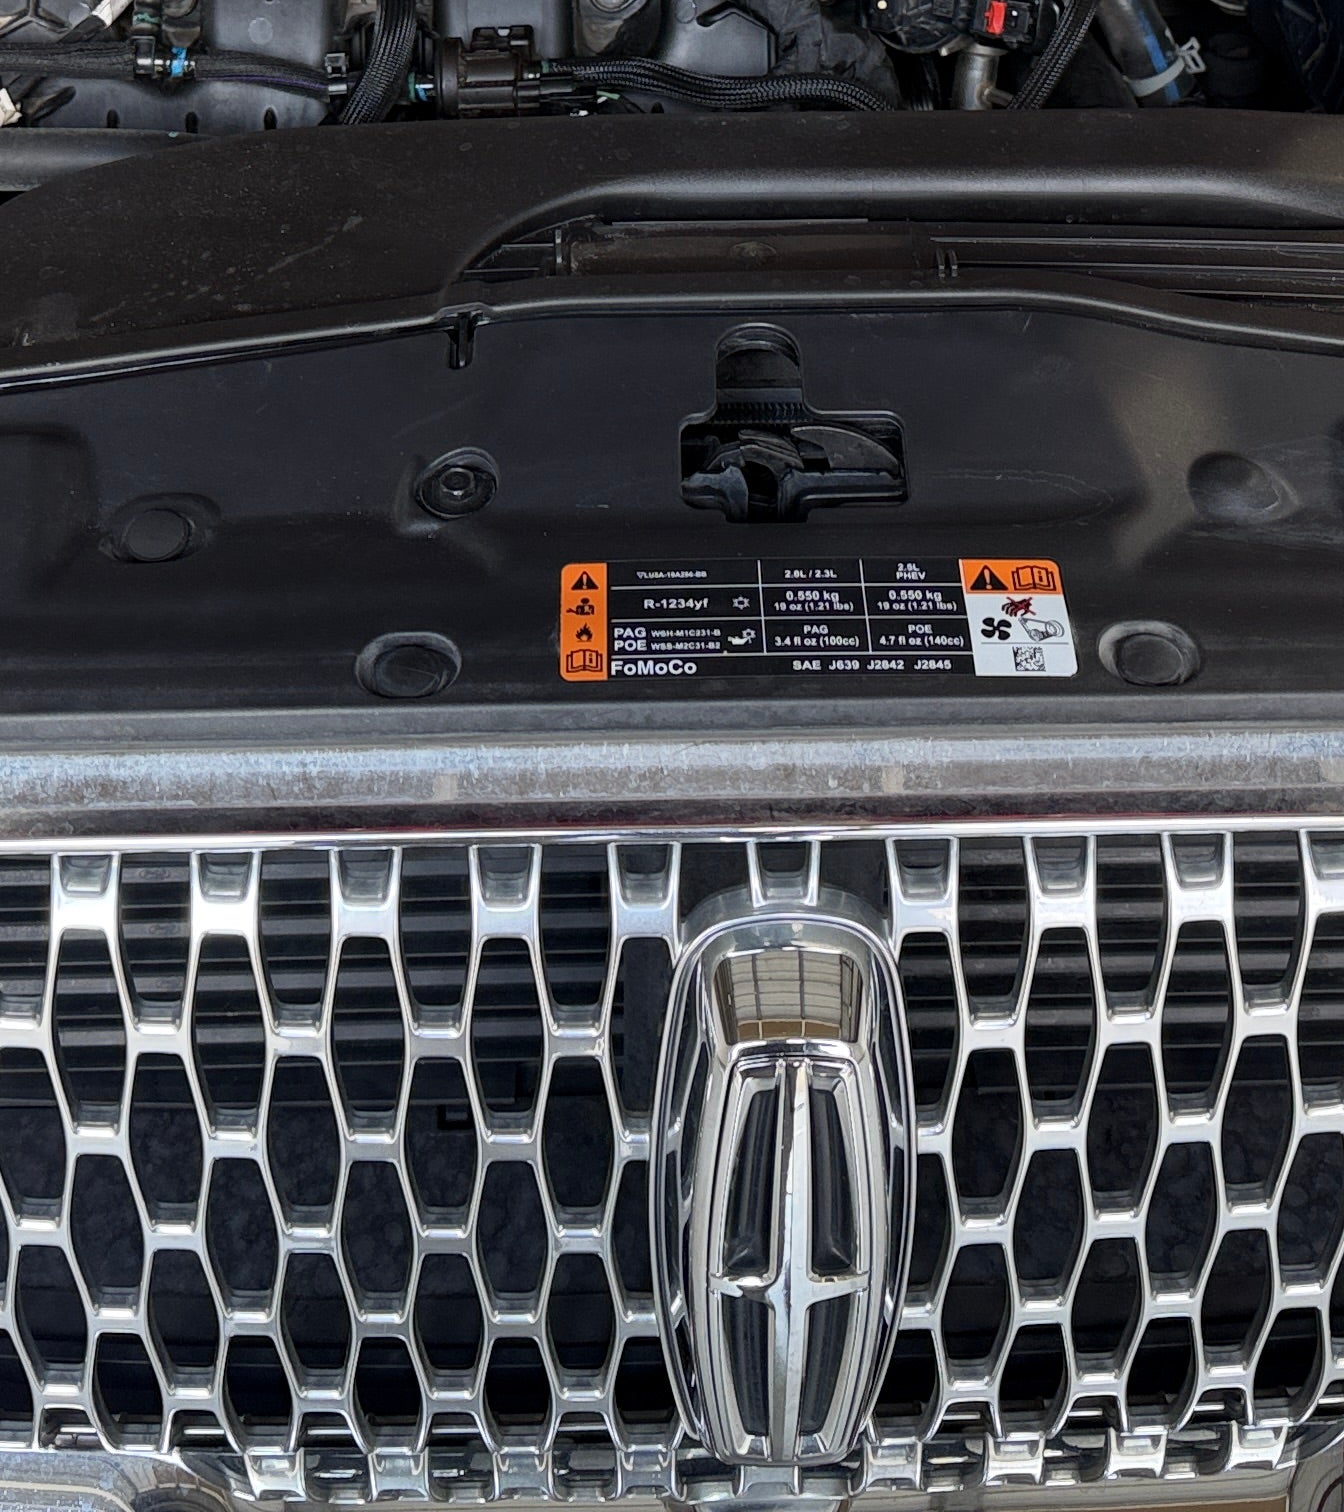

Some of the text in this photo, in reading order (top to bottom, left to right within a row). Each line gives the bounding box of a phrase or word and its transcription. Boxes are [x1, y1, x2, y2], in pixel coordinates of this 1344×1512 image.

[785, 570, 806, 578] 2.0L
[815, 569, 837, 578] 2.3L
[896, 572, 925, 580] PHEV
[786, 591, 839, 603] 0.550 kg
[889, 590, 942, 603] 0.550 kg
[644, 598, 708, 610] R-1234yf
[774, 602, 786, 611] 19
[805, 602, 829, 612] (1.21
[833, 600, 853, 611] lbs)
[878, 602, 889, 610] 19
[908, 601, 933, 611] (1.21
[936, 600, 956, 611] lbs)
[614, 627, 646, 638] PAG
[804, 625, 828, 634] PAG
[908, 624, 932, 634] POE
[614, 640, 647, 651] POE
[775, 636, 859, 647] 3.4 fl oz (100cc)
[880, 636, 895, 645] 4.7
[898, 636, 906, 645] fl
[925, 635, 964, 647] (140cc)
[611, 658, 697, 675] FoMoCo
[793, 660, 951, 670] SAE J639 J2842 J2845
